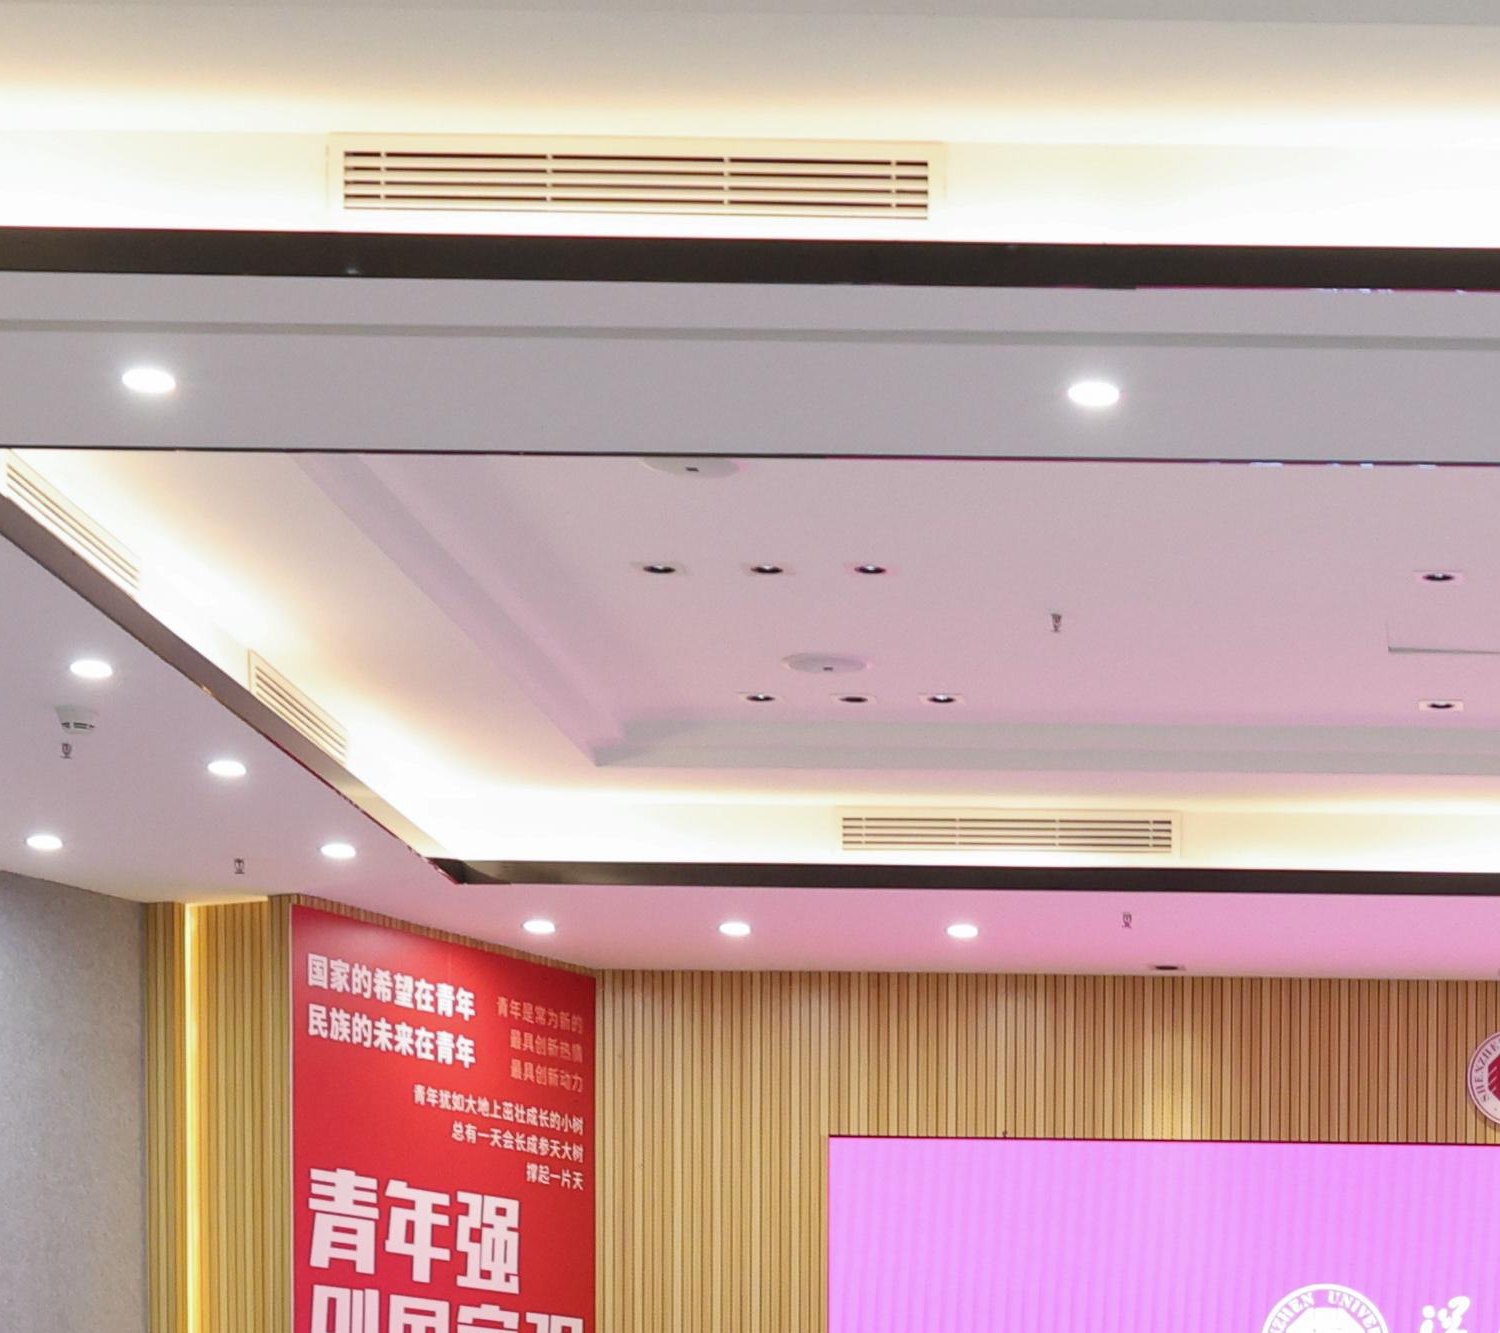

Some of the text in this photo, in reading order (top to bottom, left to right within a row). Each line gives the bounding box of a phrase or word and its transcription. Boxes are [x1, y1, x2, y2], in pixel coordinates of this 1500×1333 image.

[307, 953, 477, 1021] 国家的希望在青年
[308, 1003, 477, 1069] 民族的未来在青年
[510, 1058, 583, 1093] 最具创新动力
[413, 1083, 584, 1137] 青年犹如大地上茁壮成长的小树
[451, 1120, 584, 1163] 总有一天会长成参天大树
[526, 1162, 584, 1191] 撑起一片天
[309, 1167, 521, 1296] 青年强
